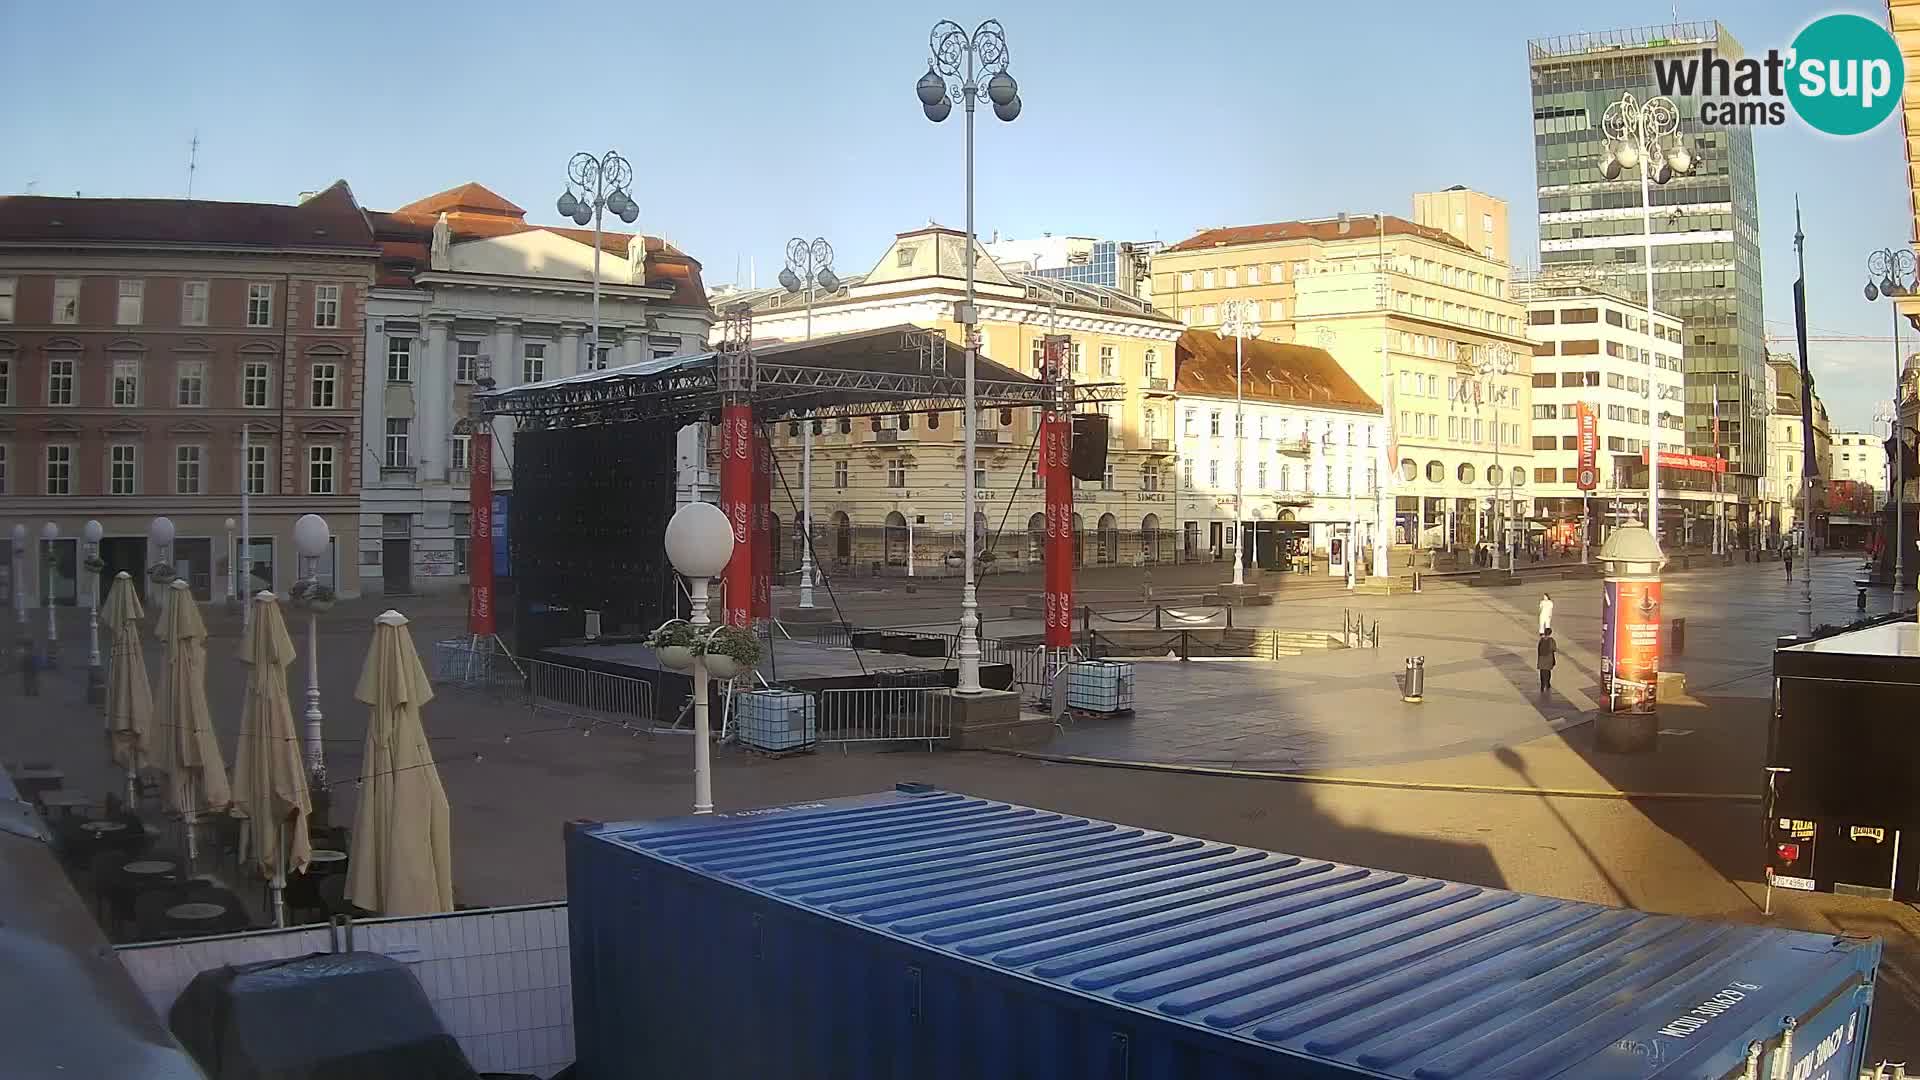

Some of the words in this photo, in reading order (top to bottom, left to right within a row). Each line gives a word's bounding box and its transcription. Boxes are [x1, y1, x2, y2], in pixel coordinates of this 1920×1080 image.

[960, 490, 996, 500] SGER
[1657, 1015, 1708, 1038] MCDU
[1690, 988, 1746, 1018] 300629
